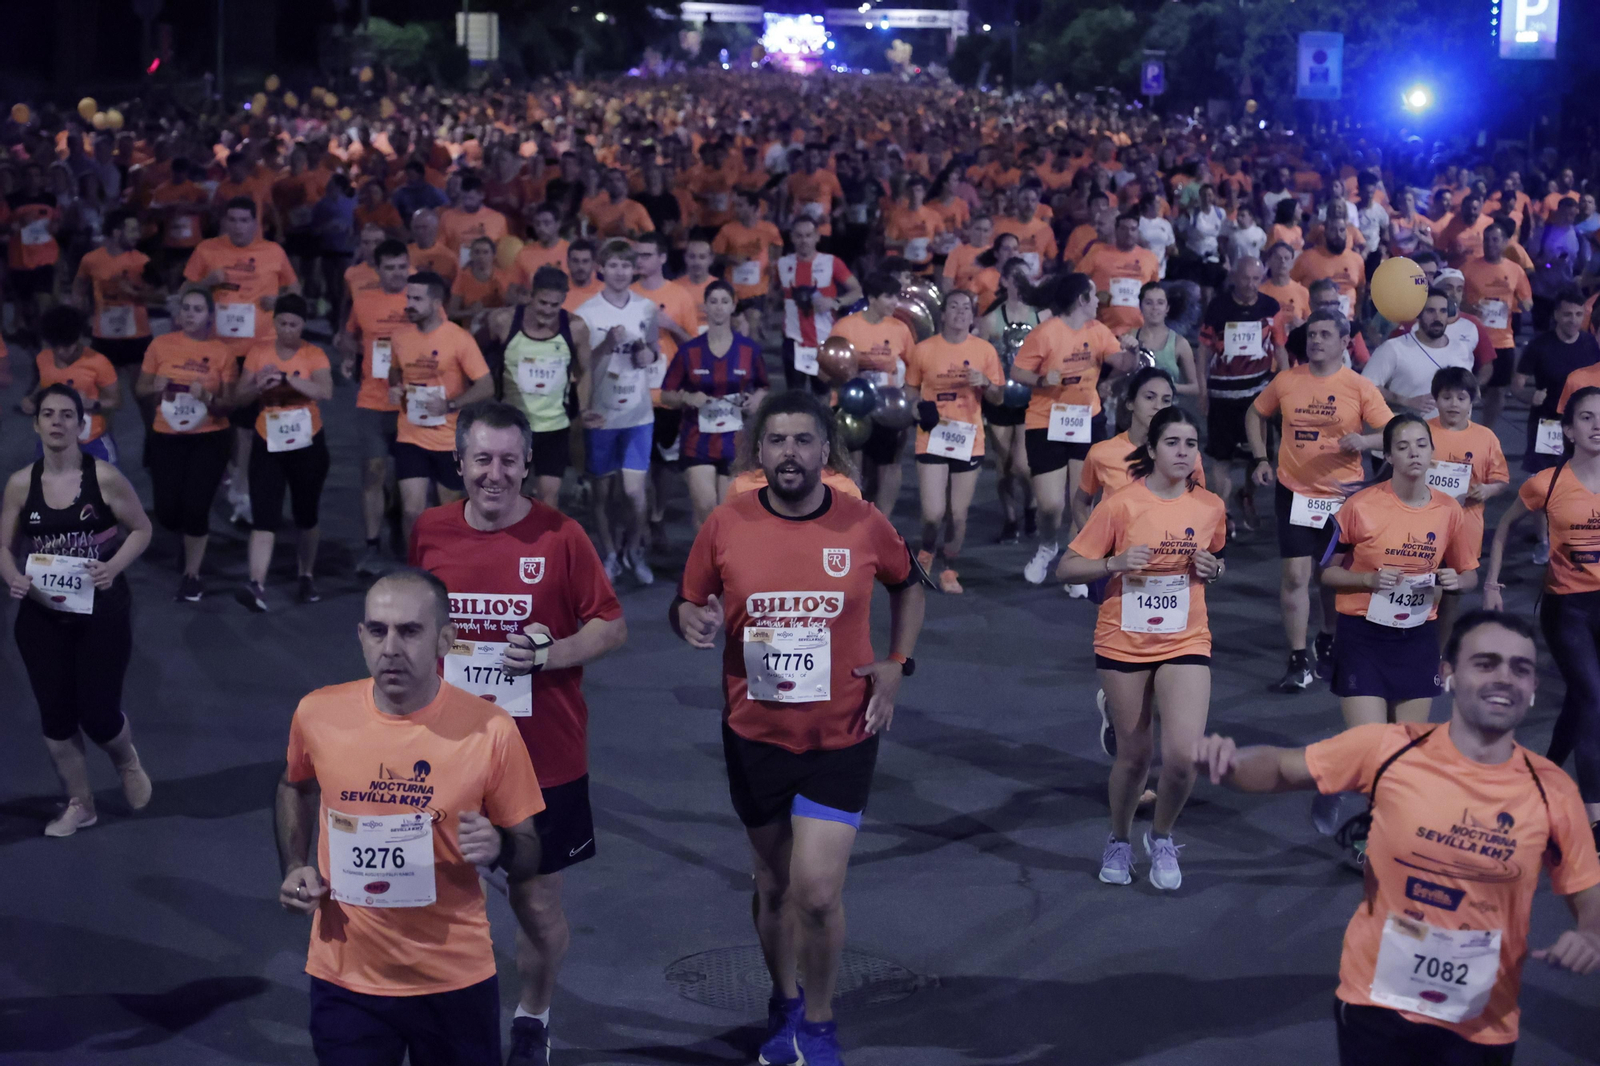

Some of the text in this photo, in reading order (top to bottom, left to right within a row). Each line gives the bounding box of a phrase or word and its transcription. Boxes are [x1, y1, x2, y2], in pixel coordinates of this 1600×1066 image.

[1232, 332, 1256, 342] 21797
[1060, 416, 1084, 427] 19508
[941, 431, 967, 444] 19509
[1429, 475, 1460, 489] 20585
[1307, 498, 1332, 511] 8588
[1149, 547, 1197, 556] VILLA KH7
[1385, 548, 1435, 560] SEVILLA KH7
[1402, 543, 1437, 552] NOCTURNA
[41, 573, 82, 590] 17443
[448, 598, 528, 616] BILIO'S
[751, 595, 839, 613] BILIO'S
[1137, 595, 1178, 609] 14308
[1388, 591, 1425, 607] 14323
[454, 618, 518, 634] imply the best
[762, 652, 814, 671] 17776
[463, 665, 514, 686] 17774
[369, 780, 434, 795] NOCTURNA
[340, 790, 432, 808] SEVILLA KH7
[1415, 826, 1515, 862] SEVILLA KH7
[1450, 824, 1517, 848] NOCTURNA
[352, 846, 405, 869] 3276
[1413, 953, 1469, 986] 7082
